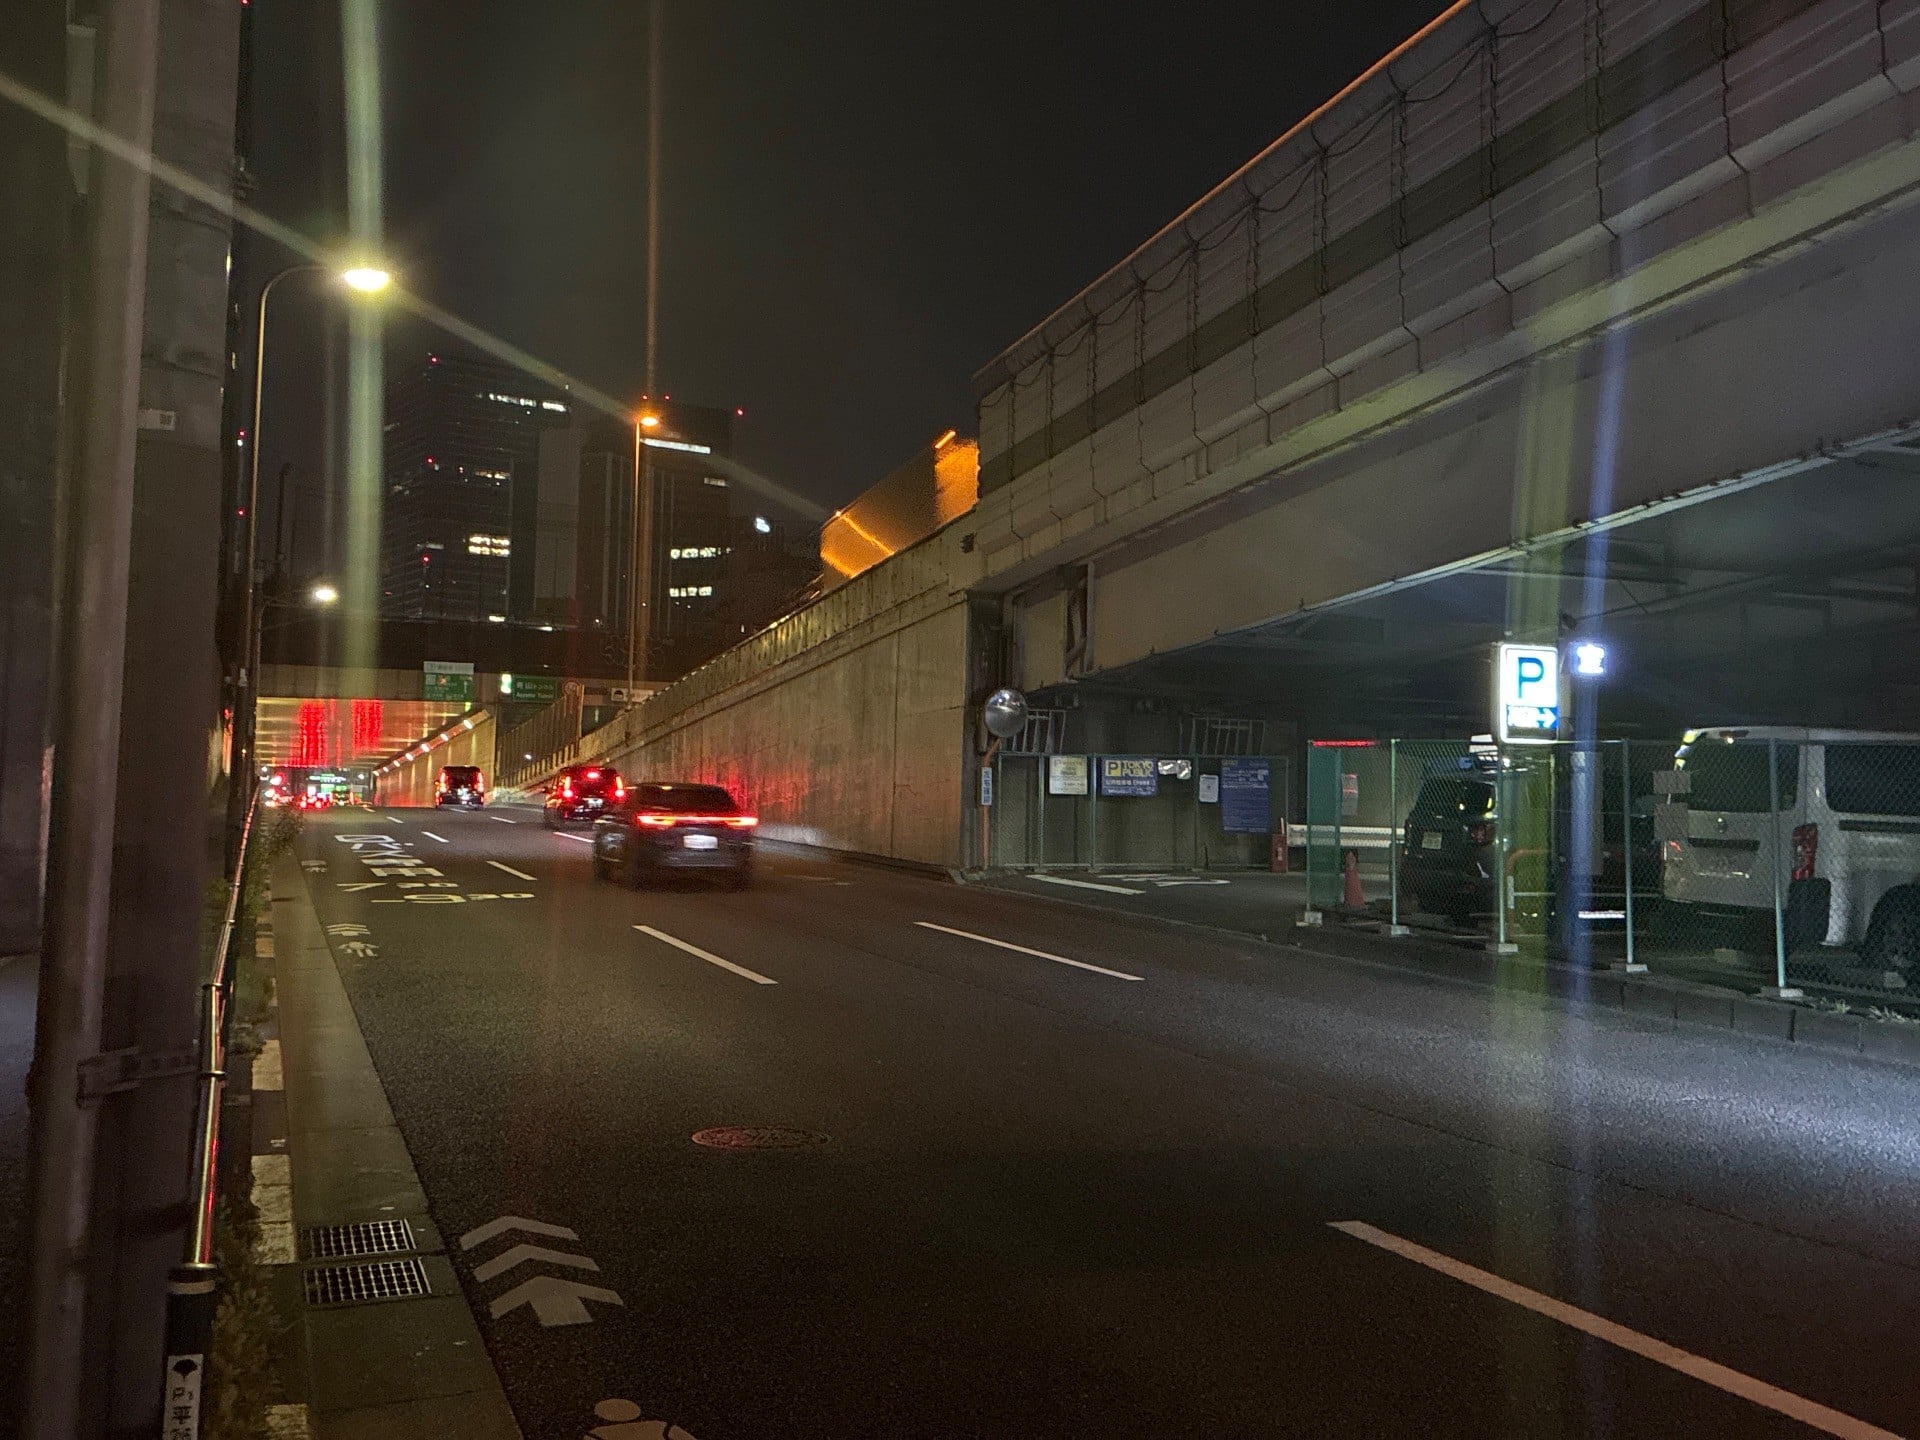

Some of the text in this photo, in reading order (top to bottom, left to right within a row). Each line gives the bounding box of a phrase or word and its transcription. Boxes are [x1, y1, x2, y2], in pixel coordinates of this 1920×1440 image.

[1517, 657, 1544, 699] P
[1121, 760, 1154, 769] TOKYO
[1122, 769, 1154, 777] PUBLIC
